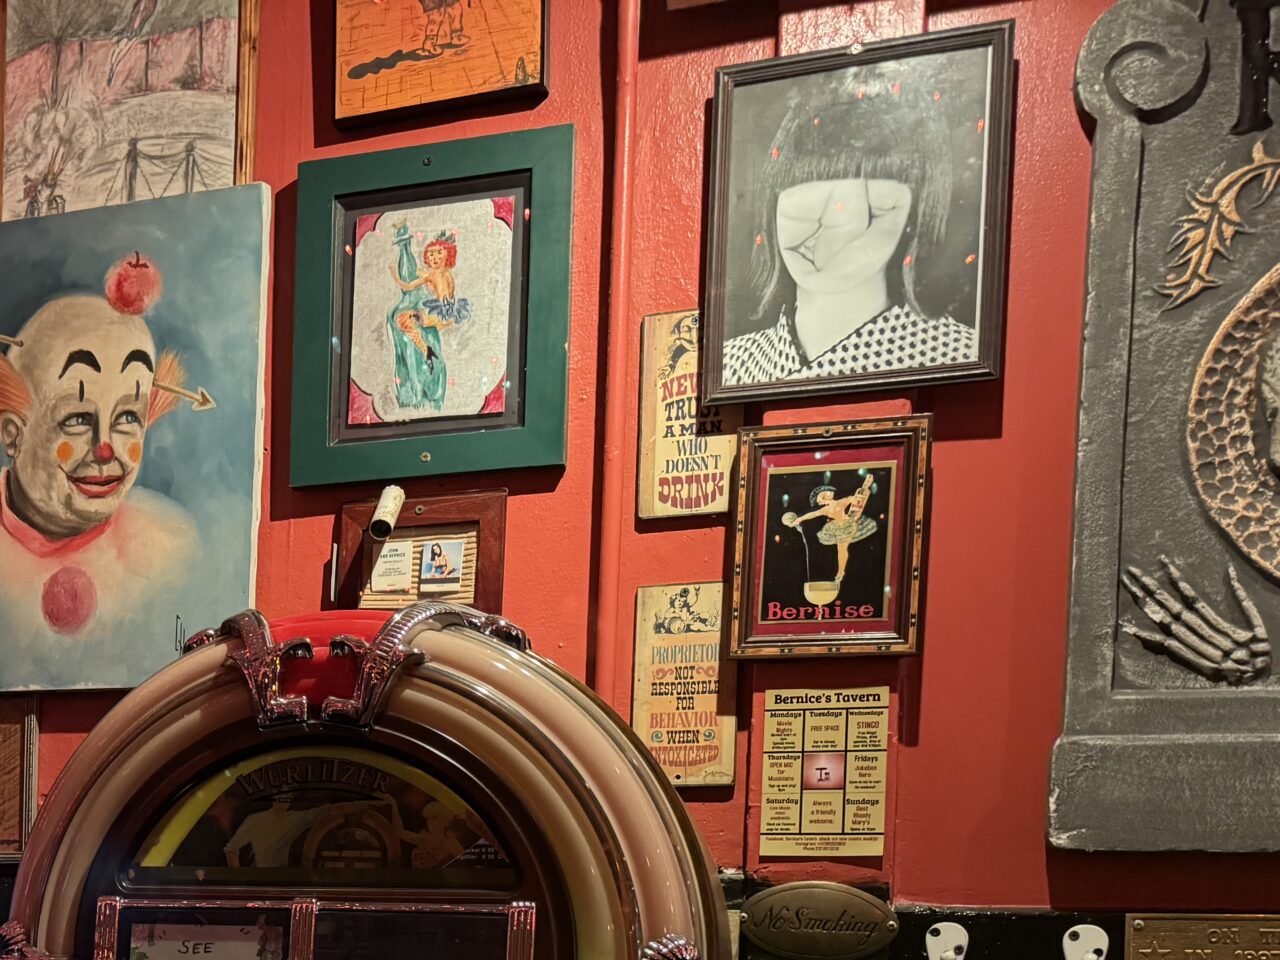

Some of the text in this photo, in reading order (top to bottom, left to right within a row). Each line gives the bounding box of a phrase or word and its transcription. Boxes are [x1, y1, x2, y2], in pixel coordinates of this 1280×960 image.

[661, 372, 697, 402] NEV
[665, 396, 720, 422] TRUST
[662, 420, 723, 438] A MAN
[676, 436, 708, 456] WHO
[665, 454, 721, 474] DOESN'T
[658, 472, 724, 510] DRINK
[767, 600, 875, 620] Bernise
[674, 666, 695, 680] NOT
[651, 680, 719, 696] RESPONSIBLE
[676, 697, 694, 710] FOR
[774, 692, 880, 704] Bernice's Tavern
[650, 711, 719, 729] BEHAVIOR
[770, 711, 801, 719] Mondays
[857, 721, 879, 729] STINGO
[666, 730, 699, 744] WHEN
[855, 755, 878, 763] Fridays
[237, 759, 390, 795] WURLITZER
[846, 798, 880, 806] Sundays
[754, 905, 879, 947] No Smoking
[1208, 928, 1239, 944] ON
[177, 940, 214, 954] SEE
